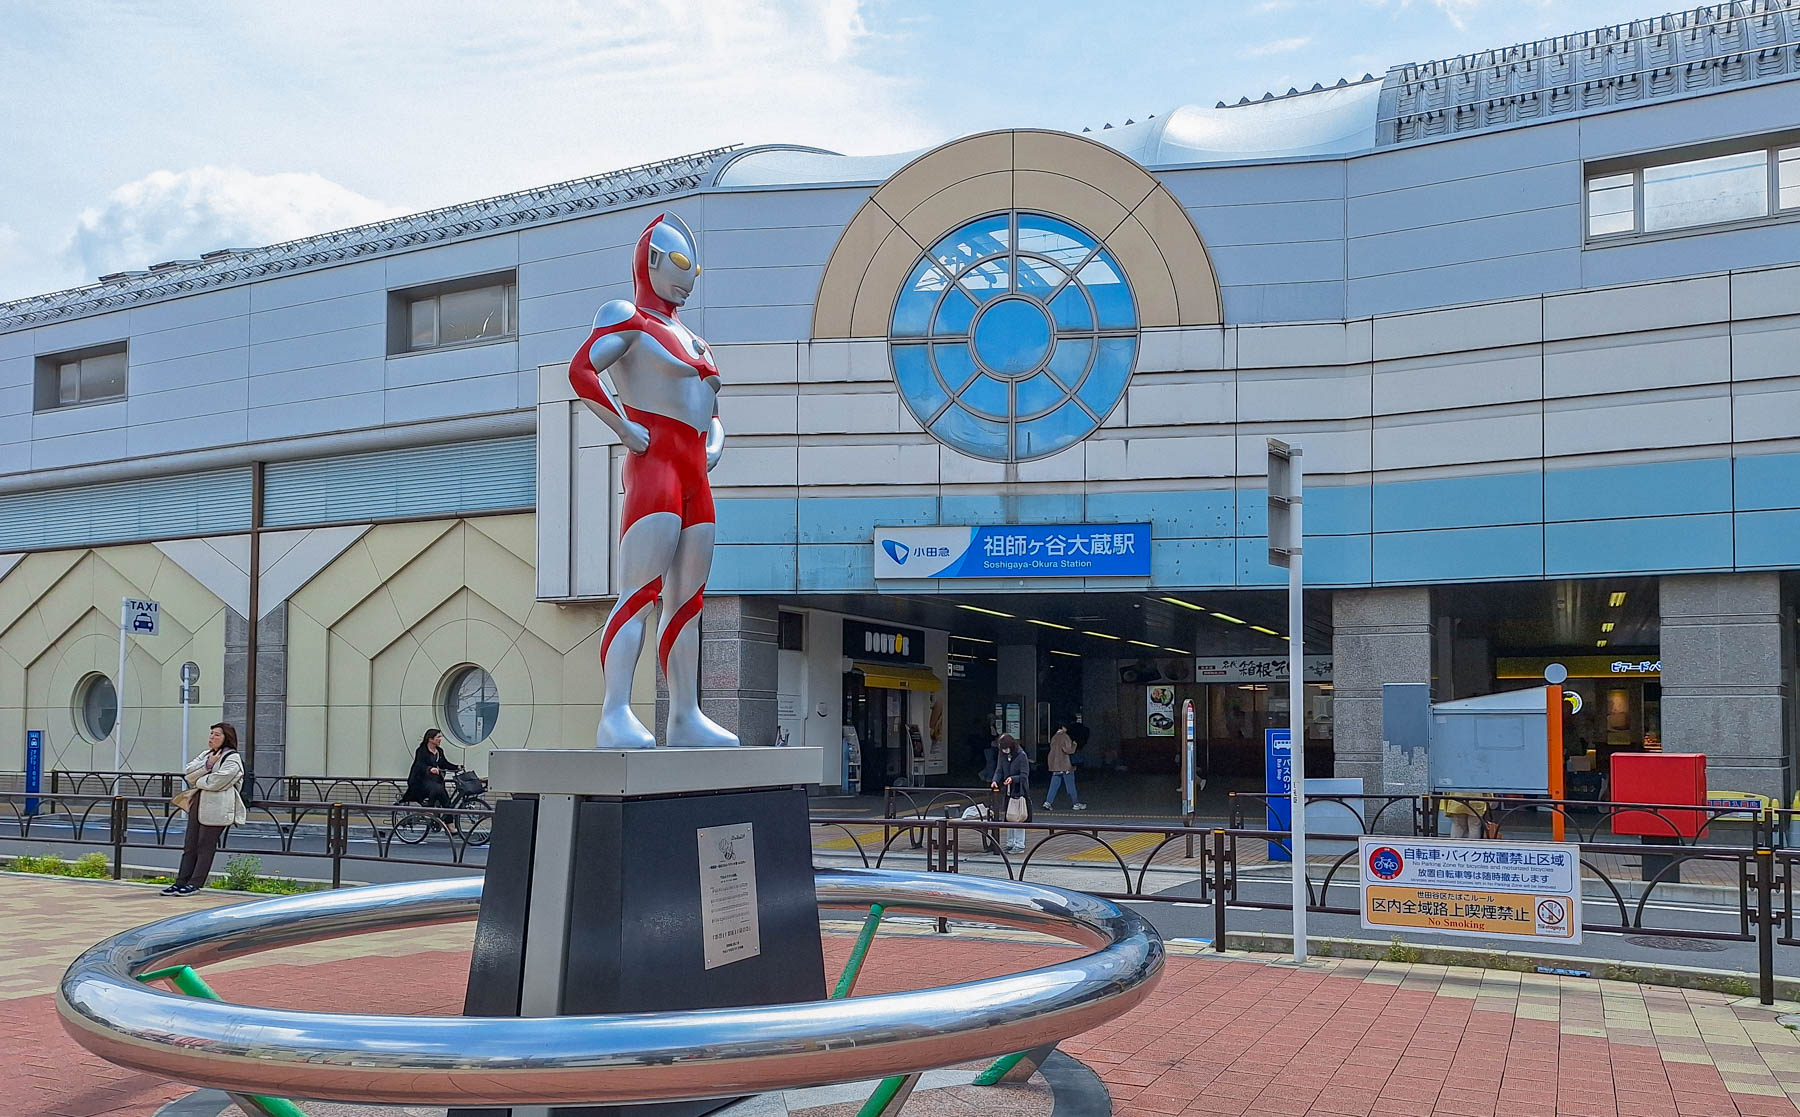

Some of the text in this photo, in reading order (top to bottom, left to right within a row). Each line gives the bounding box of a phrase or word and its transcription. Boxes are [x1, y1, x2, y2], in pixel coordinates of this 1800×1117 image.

[913, 546, 950, 558] 小田急
[983, 559, 1092, 570] Soshigaya-Okura Station
[130, 601, 158, 612] TAXI
[865, 631, 910, 656] DOUTOR
[1239, 660, 1290, 678] 箱根そ
[1418, 868, 1549, 883] 放置自転車等は随時撤去します
[1417, 891, 1495, 903] 世田谷区たばこルール
[1372, 898, 1530, 922] 区内全域路上喫煙禁止
[1428, 917, 1485, 930] No Smoking
